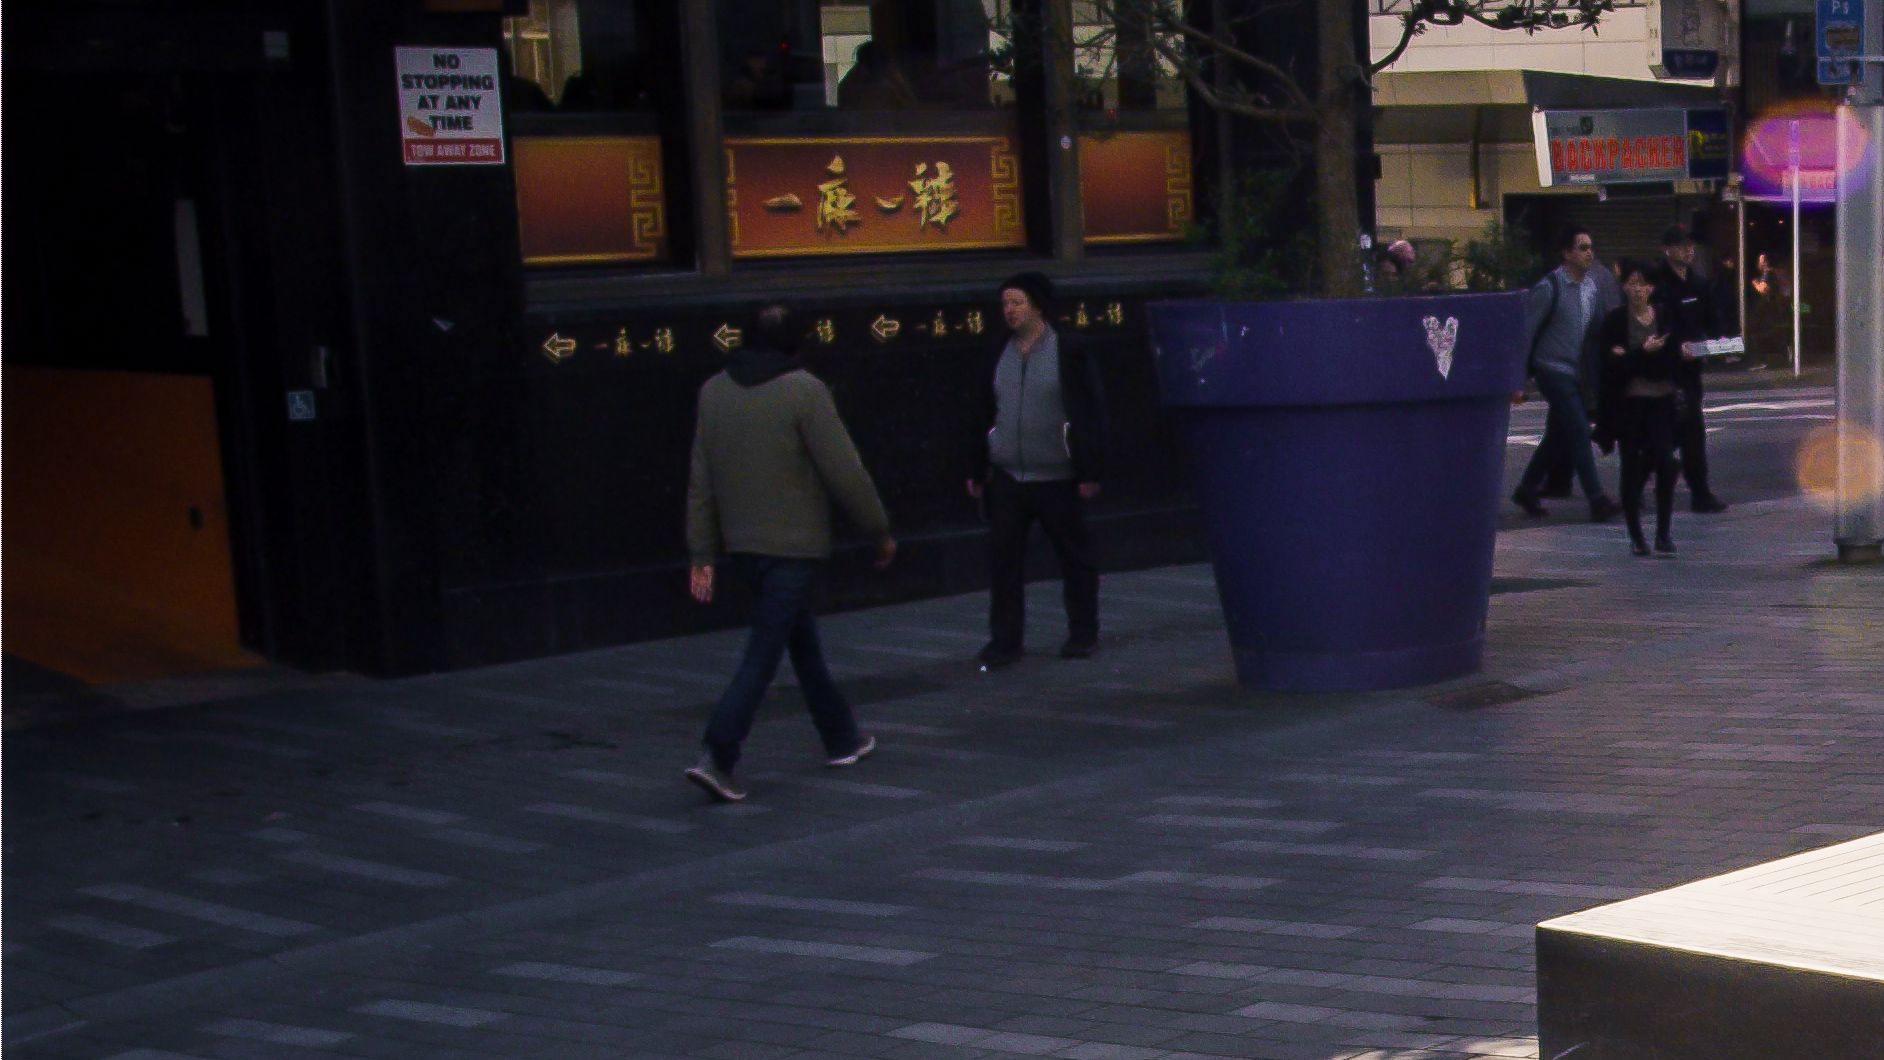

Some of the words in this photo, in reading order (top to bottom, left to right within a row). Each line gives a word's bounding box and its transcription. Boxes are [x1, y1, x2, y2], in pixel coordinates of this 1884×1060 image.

[433, 54, 459, 69] NO
[401, 74, 494, 90] STOPPING
[417, 95, 440, 110] AT
[445, 95, 481, 110] ANY
[429, 115, 473, 131] TIME
[411, 144, 434, 157] TOW
[436, 144, 466, 157] AWAY
[469, 144, 495, 157] ZONE
